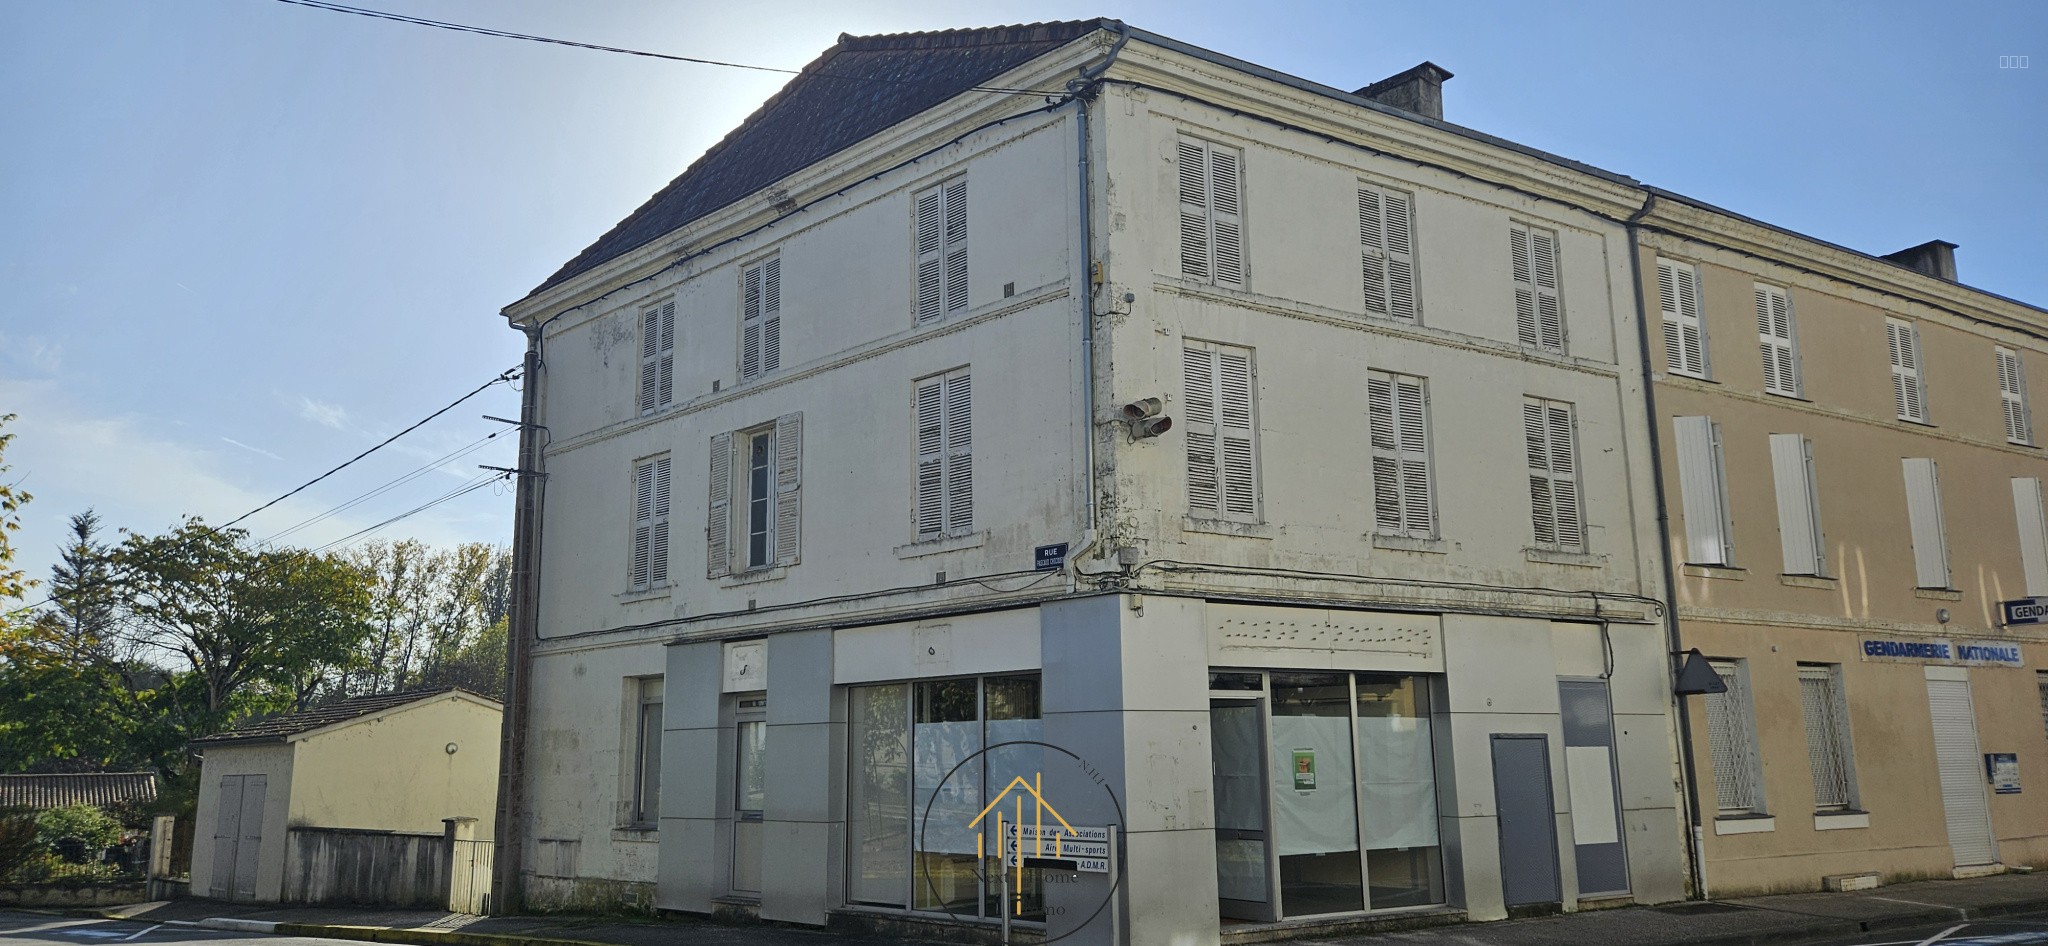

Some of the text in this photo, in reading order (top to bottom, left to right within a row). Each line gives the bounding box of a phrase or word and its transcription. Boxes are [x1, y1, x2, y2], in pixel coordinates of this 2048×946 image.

[1044, 548, 1058, 556] RUE
[1863, 640, 2020, 662] GENDARMERIE NATIONALE
[1022, 827, 1106, 838] Maisn de Asociations
[1045, 843, 1106, 855] Air Multi-sports
